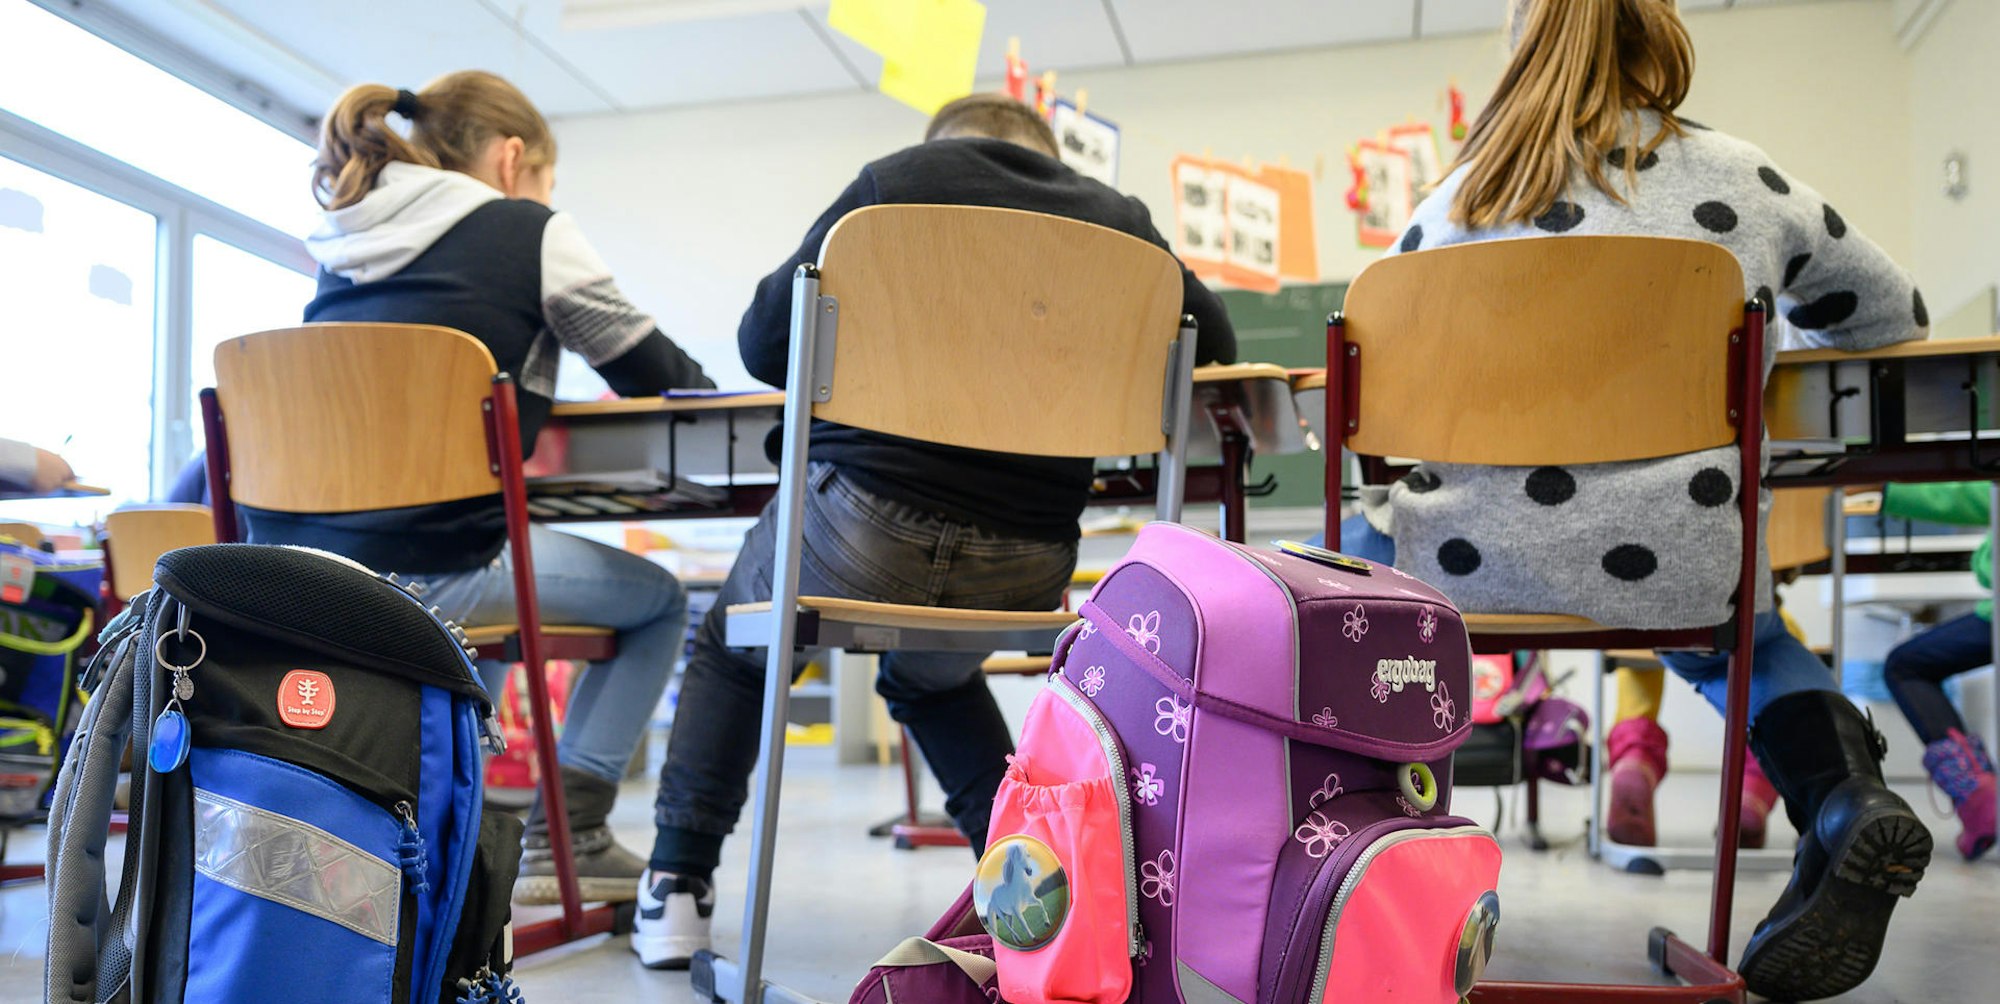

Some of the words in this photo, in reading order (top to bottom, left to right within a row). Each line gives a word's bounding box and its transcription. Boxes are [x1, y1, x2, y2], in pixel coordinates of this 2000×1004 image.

[1377, 655, 1436, 692] ergobag
[287, 706, 301, 715] Step
[302, 708, 311, 716] by
